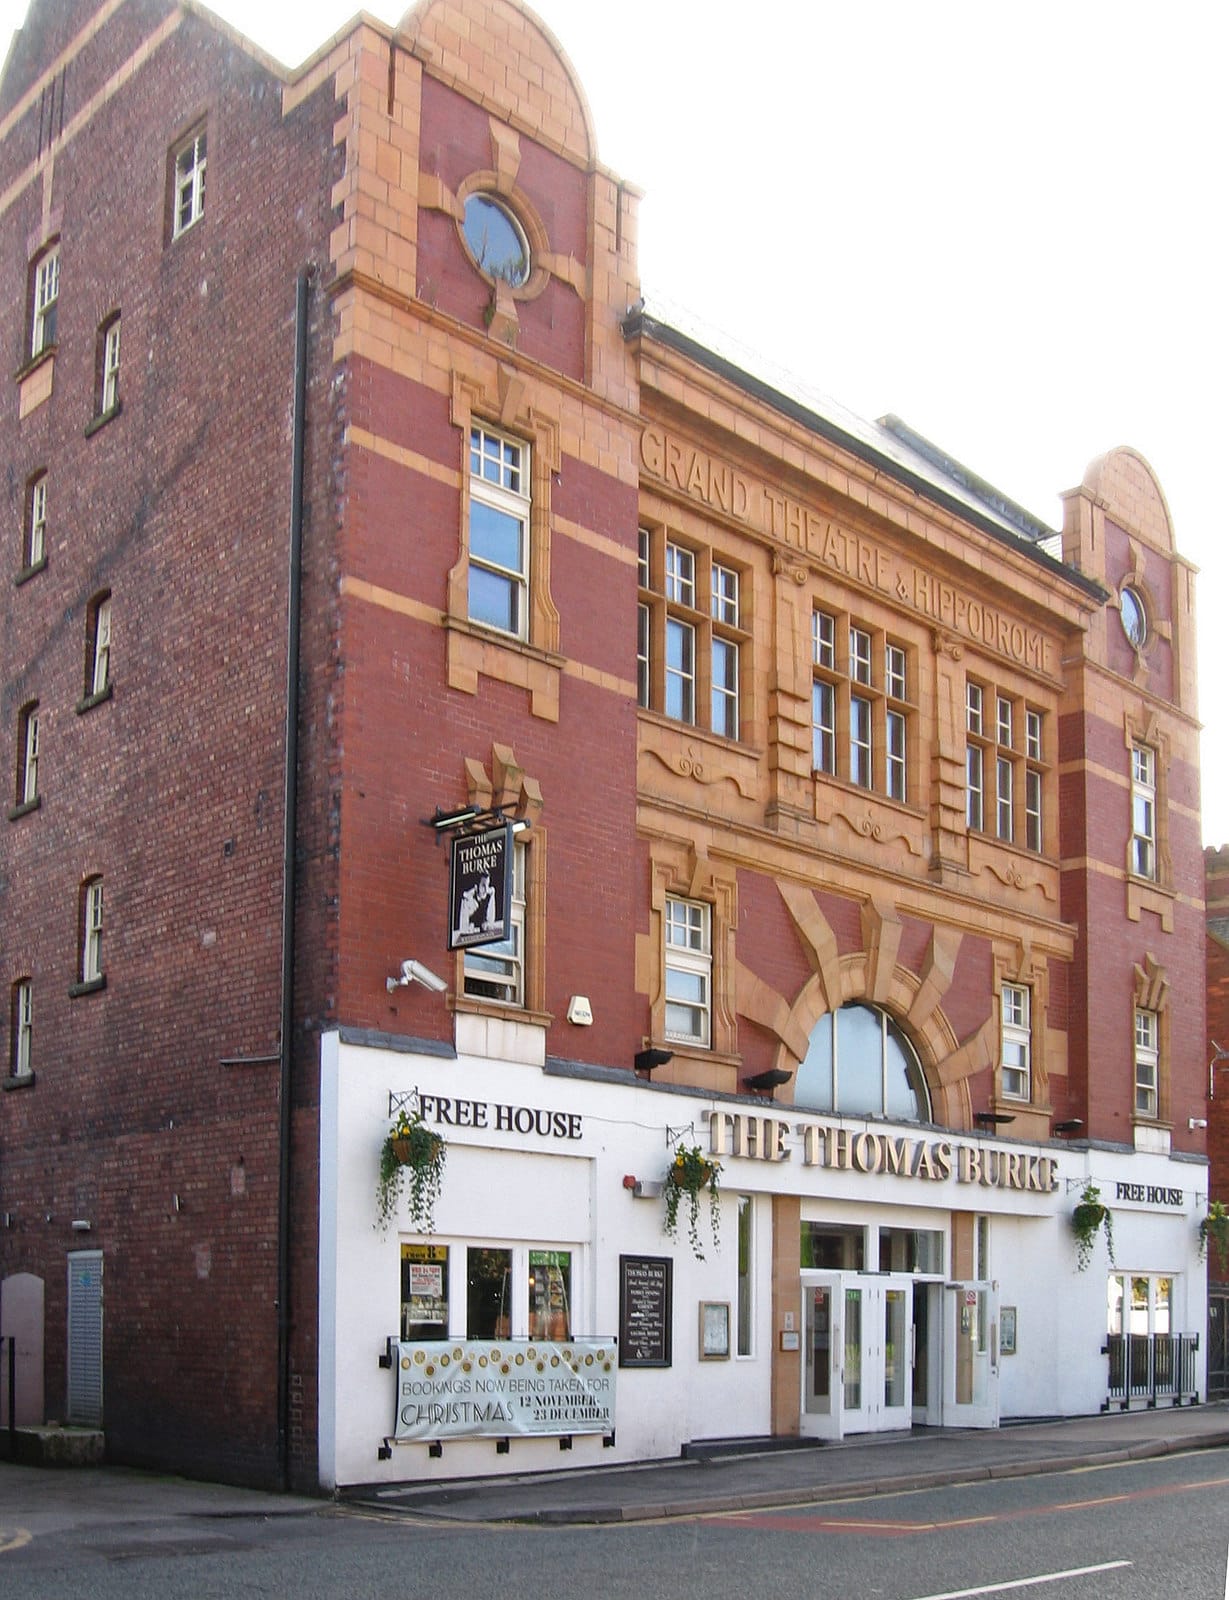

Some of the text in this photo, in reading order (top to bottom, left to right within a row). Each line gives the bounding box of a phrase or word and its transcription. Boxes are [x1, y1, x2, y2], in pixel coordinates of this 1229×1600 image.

[639, 427, 1052, 674] GRAND THEATRE & HIPPODROME
[473, 832, 487, 846] THE
[459, 840, 503, 863] THOMAS
[462, 855, 497, 875] BURKE
[419, 1094, 583, 1140] FREE HOUSE
[702, 1109, 1060, 1193] THE THOMAS BURKE
[1115, 1181, 1184, 1206] FREE HOUSE
[402, 1378, 609, 1396] BOOKINGS NOW BEING TAKEN FOR
[519, 1395, 532, 1408] 12
[400, 1401, 515, 1427] CHRISTMAS
[533, 1407, 610, 1421] 23 DECEMBER
